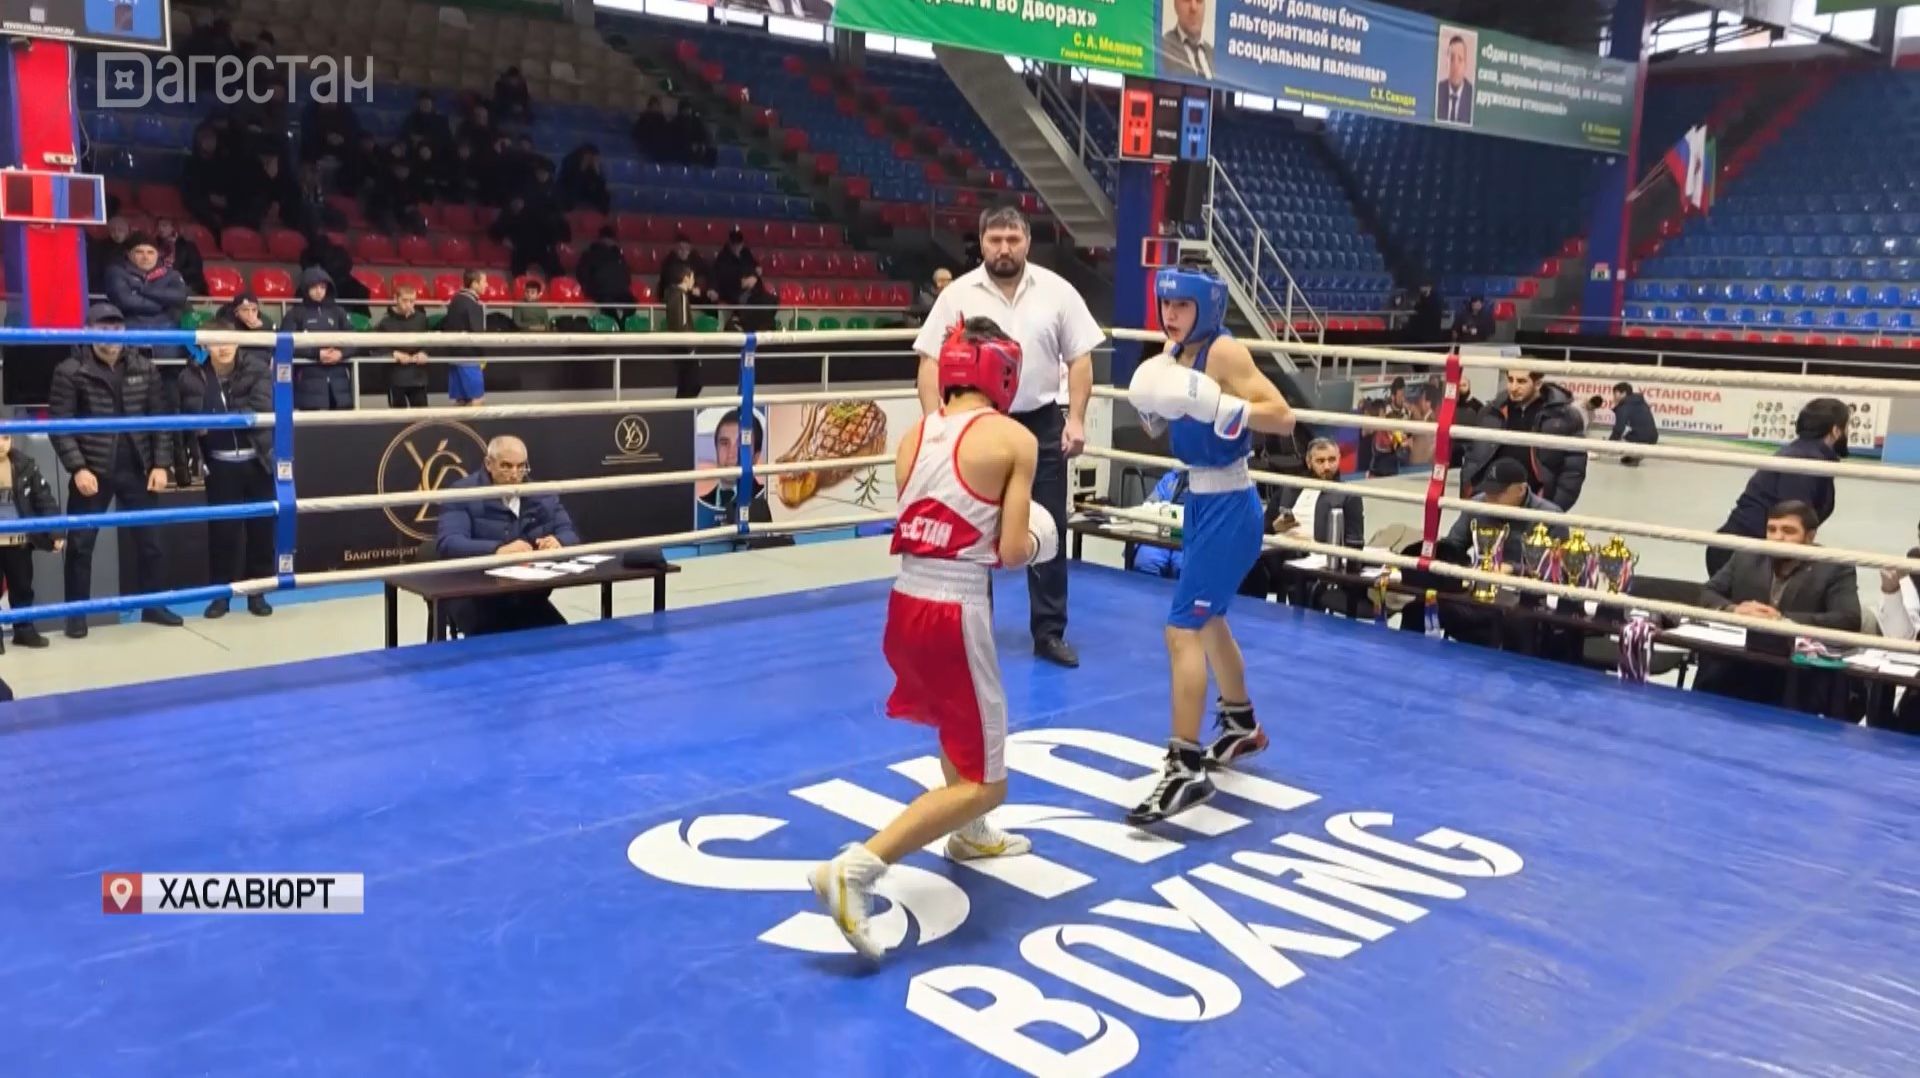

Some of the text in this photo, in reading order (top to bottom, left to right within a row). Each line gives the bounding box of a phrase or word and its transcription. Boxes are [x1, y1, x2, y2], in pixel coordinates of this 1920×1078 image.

[1021, 0, 1098, 28] дворах»
[1286, 0, 1337, 24] должен
[1338, 7, 1369, 32] быть
[1228, 12, 1361, 55] альтернативой всем
[1228, 38, 1387, 84] асоциальным явлениям»
[1638, 386, 1722, 403] УСТАНОВКА
[906, 811, 1524, 1078] BOXING
